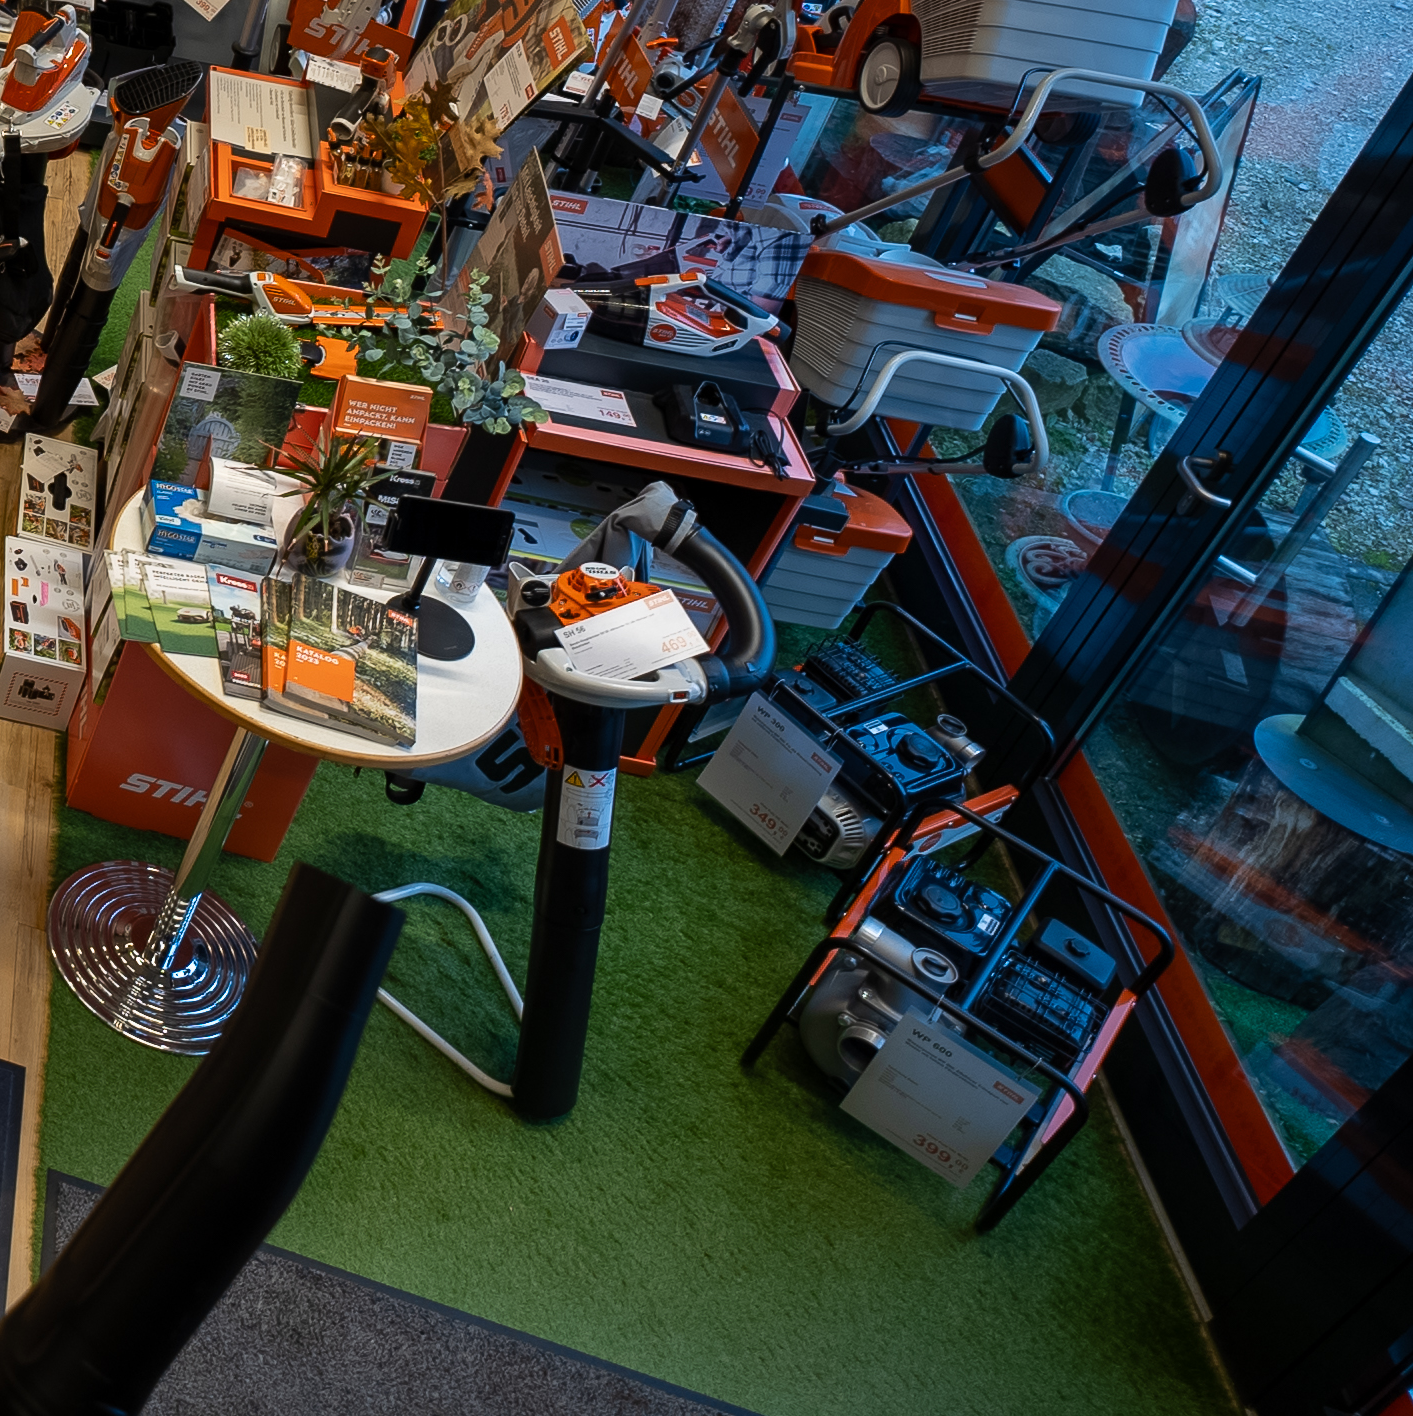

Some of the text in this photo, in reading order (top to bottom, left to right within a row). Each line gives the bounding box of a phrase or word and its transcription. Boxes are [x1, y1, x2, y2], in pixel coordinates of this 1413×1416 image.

[548, 25, 570, 62] STIHL
[707, 110, 737, 169] STIHL
[552, 199, 582, 211] STIHL
[544, 241, 557, 275] STIHL
[348, 399, 398, 413] WER NICHT
[345, 415, 397, 430] EINPACKEN!
[390, 414, 416, 425] KANN
[155, 482, 195, 495] HYGOSTAR
[157, 529, 196, 544] HYGOSTAR
[219, 574, 251, 590] Kress
[563, 628, 575, 639] SH
[295, 651, 321, 666] 2023
[296, 645, 340, 666] KATALOG
[757, 705, 771, 720] WP
[911, 1028, 955, 1058] WP 600
[995, 1082, 1023, 1103] STIHL
